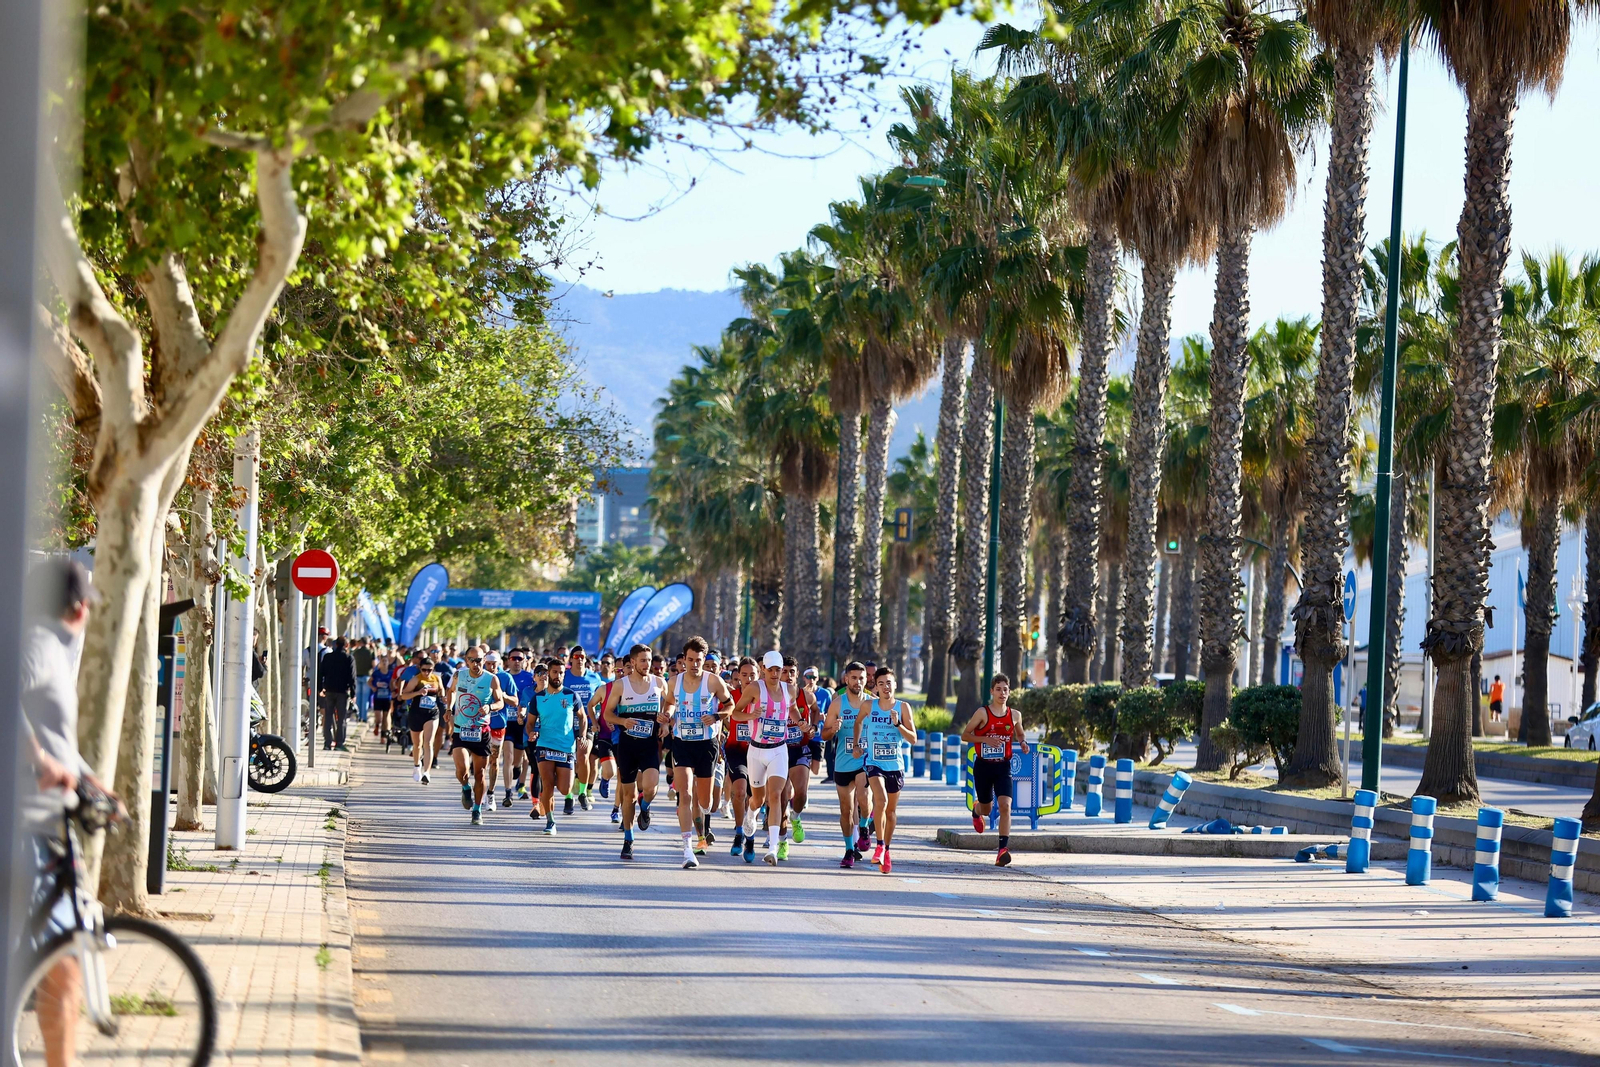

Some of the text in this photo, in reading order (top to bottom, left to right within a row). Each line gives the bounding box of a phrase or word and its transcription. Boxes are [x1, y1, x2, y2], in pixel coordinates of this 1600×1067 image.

[405, 576, 439, 629] mayoral
[549, 595, 594, 606] mayoral
[631, 596, 682, 645] mayoral
[871, 715, 893, 725] nerj
[632, 724, 651, 733] 1992
